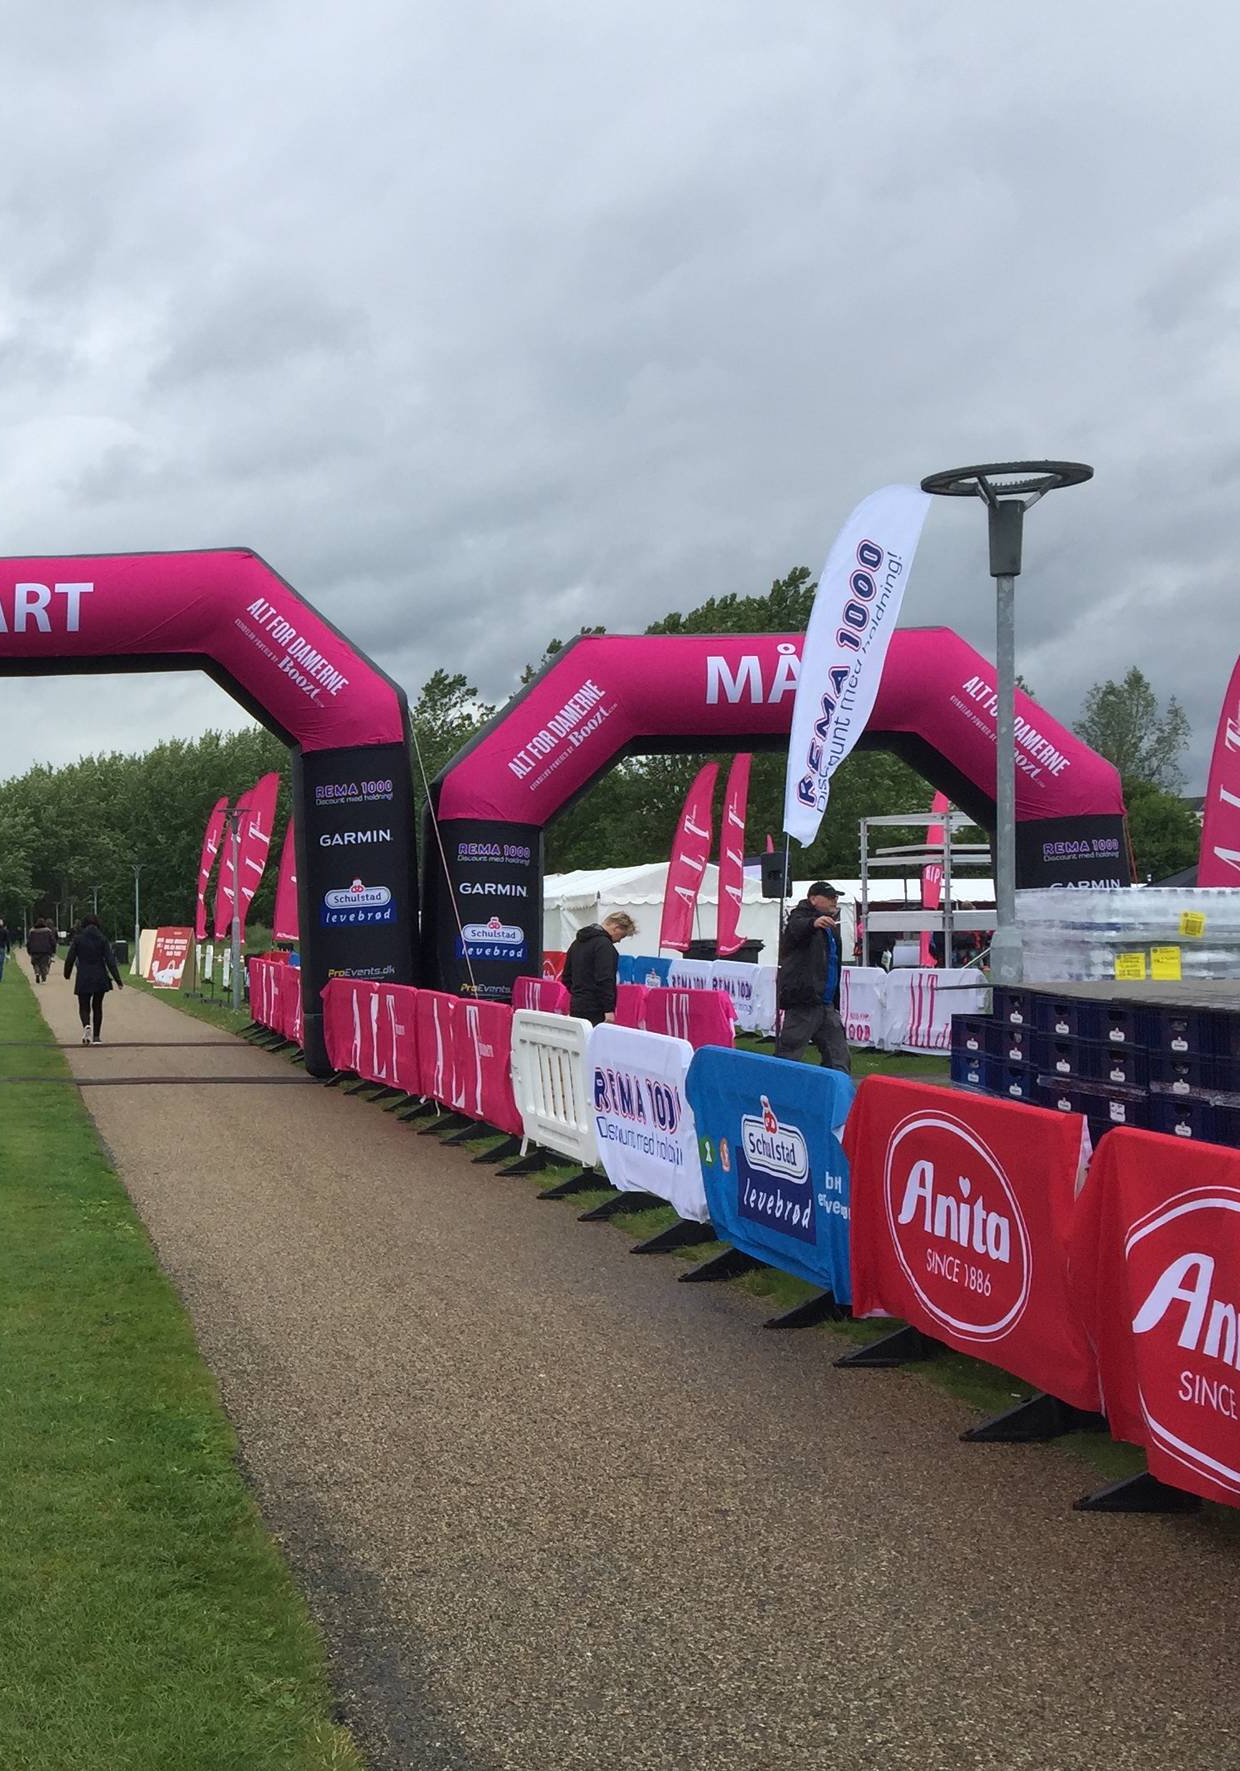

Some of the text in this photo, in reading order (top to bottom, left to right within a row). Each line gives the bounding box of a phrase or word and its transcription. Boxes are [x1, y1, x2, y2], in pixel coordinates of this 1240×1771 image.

[247, 597, 349, 696] ALT FOR DAMERNE
[706, 643, 801, 705] MÅ
[797, 539, 884, 808] REMA 1000
[507, 679, 606, 780] ALT FOR DAMERNE
[962, 675, 993, 702] ALT
[1014, 716, 1071, 777] DAMERNE
[315, 780, 393, 799] REMA 1000
[319, 829, 391, 847] GARMIN
[458, 843, 531, 859] REMA 1000
[1043, 838, 1119, 855] REMA 1000
[334, 893, 382, 904] Schulstad
[459, 882, 527, 897] GARMIN
[326, 908, 391, 923] levebrød
[471, 929, 516, 939] Schulstad
[328, 965, 396, 978] ProEvents.dk
[460, 983, 513, 993] ProEvents.
[594, 1067, 647, 1125] REMA
[748, 1132, 797, 1167] Schulstad
[743, 1178, 812, 1229] levebrød
[898, 1159, 1011, 1264] Anita
[926, 1248, 992, 1297] SINCE 1886
[1178, 1370, 1239, 1421] SINCE
